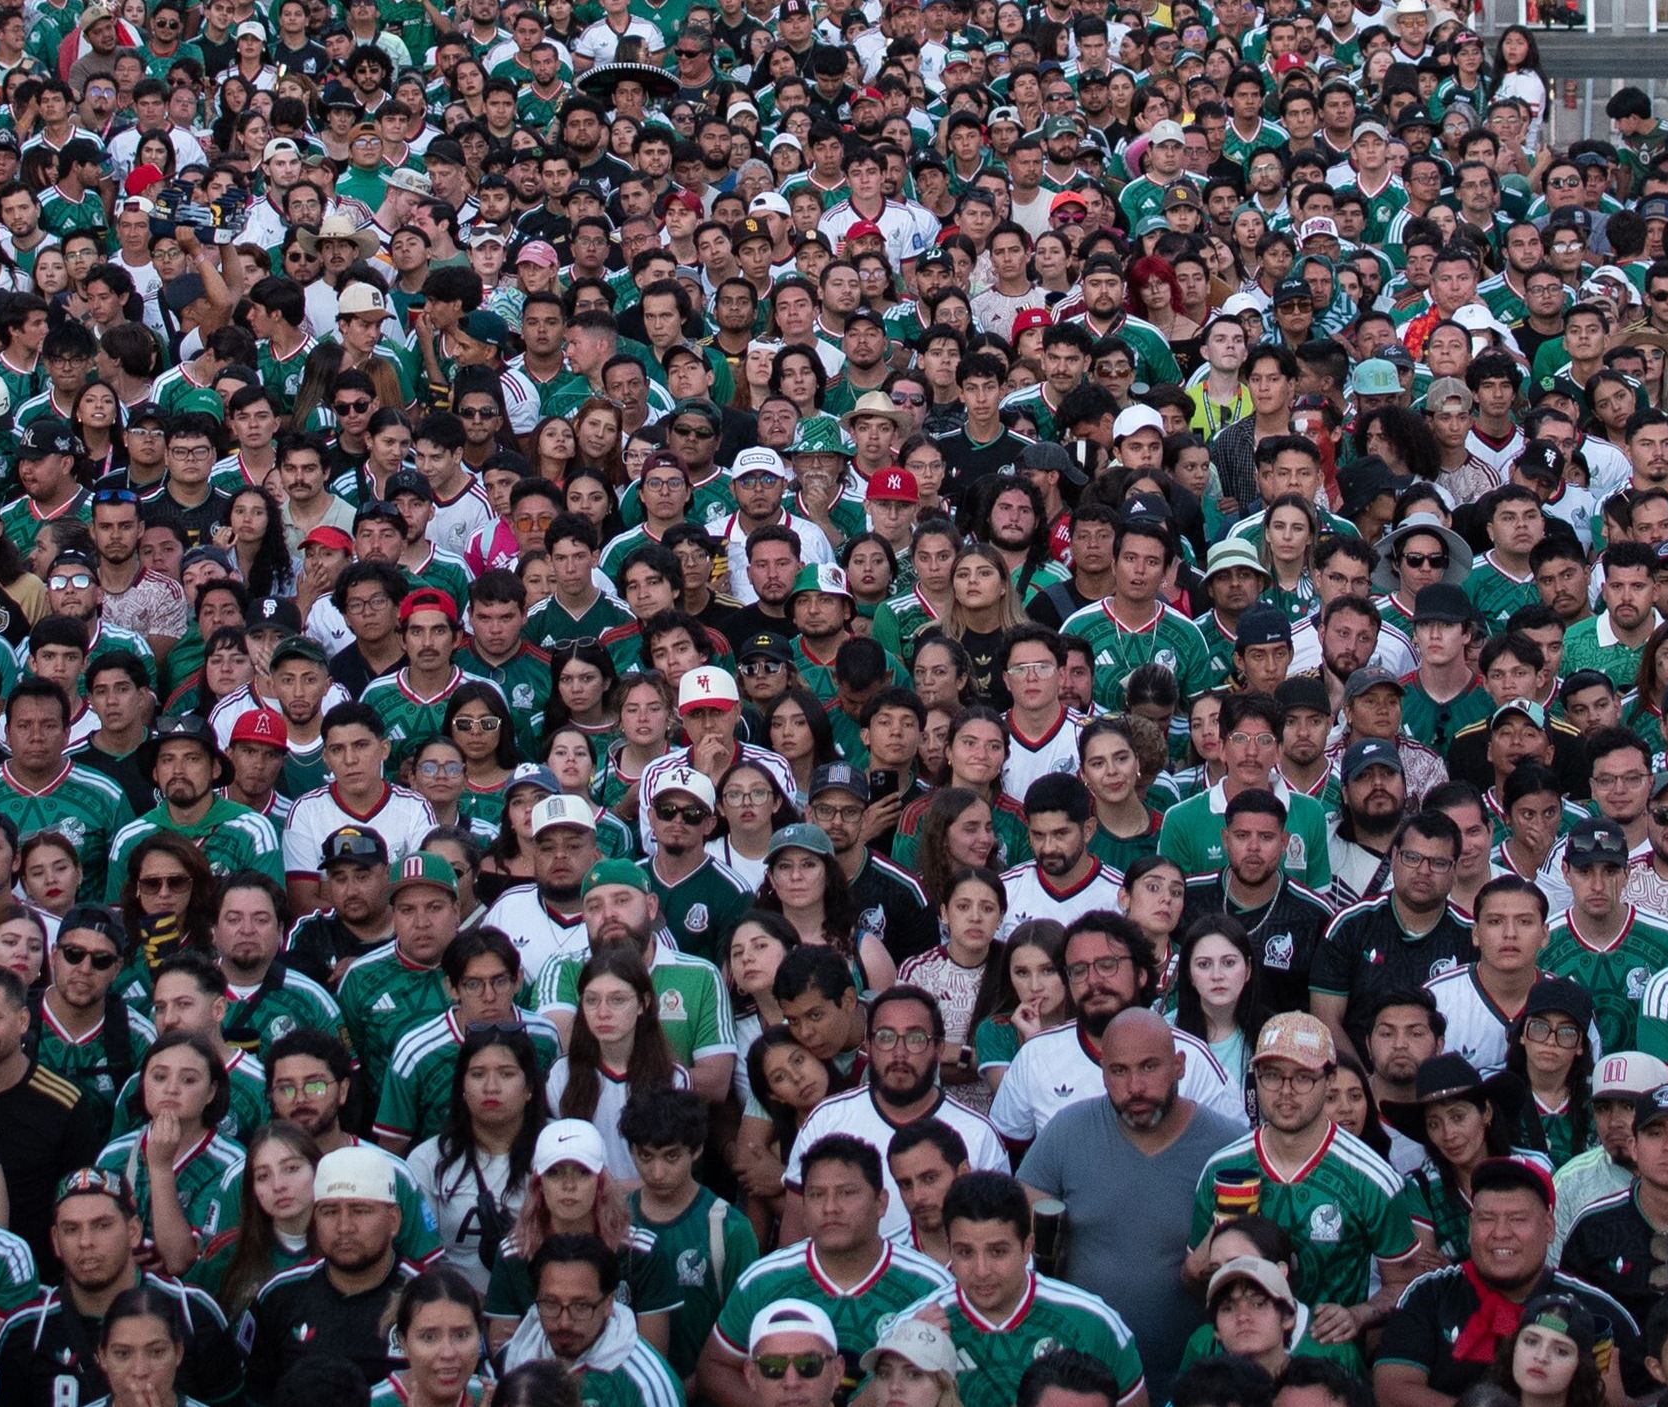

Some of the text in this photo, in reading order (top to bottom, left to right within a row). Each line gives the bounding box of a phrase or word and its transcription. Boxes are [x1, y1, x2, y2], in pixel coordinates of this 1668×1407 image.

[888, 474, 902, 490] NY
[262, 600, 276, 618] SF
[255, 713, 272, 734] A
[404, 856, 423, 878] M
